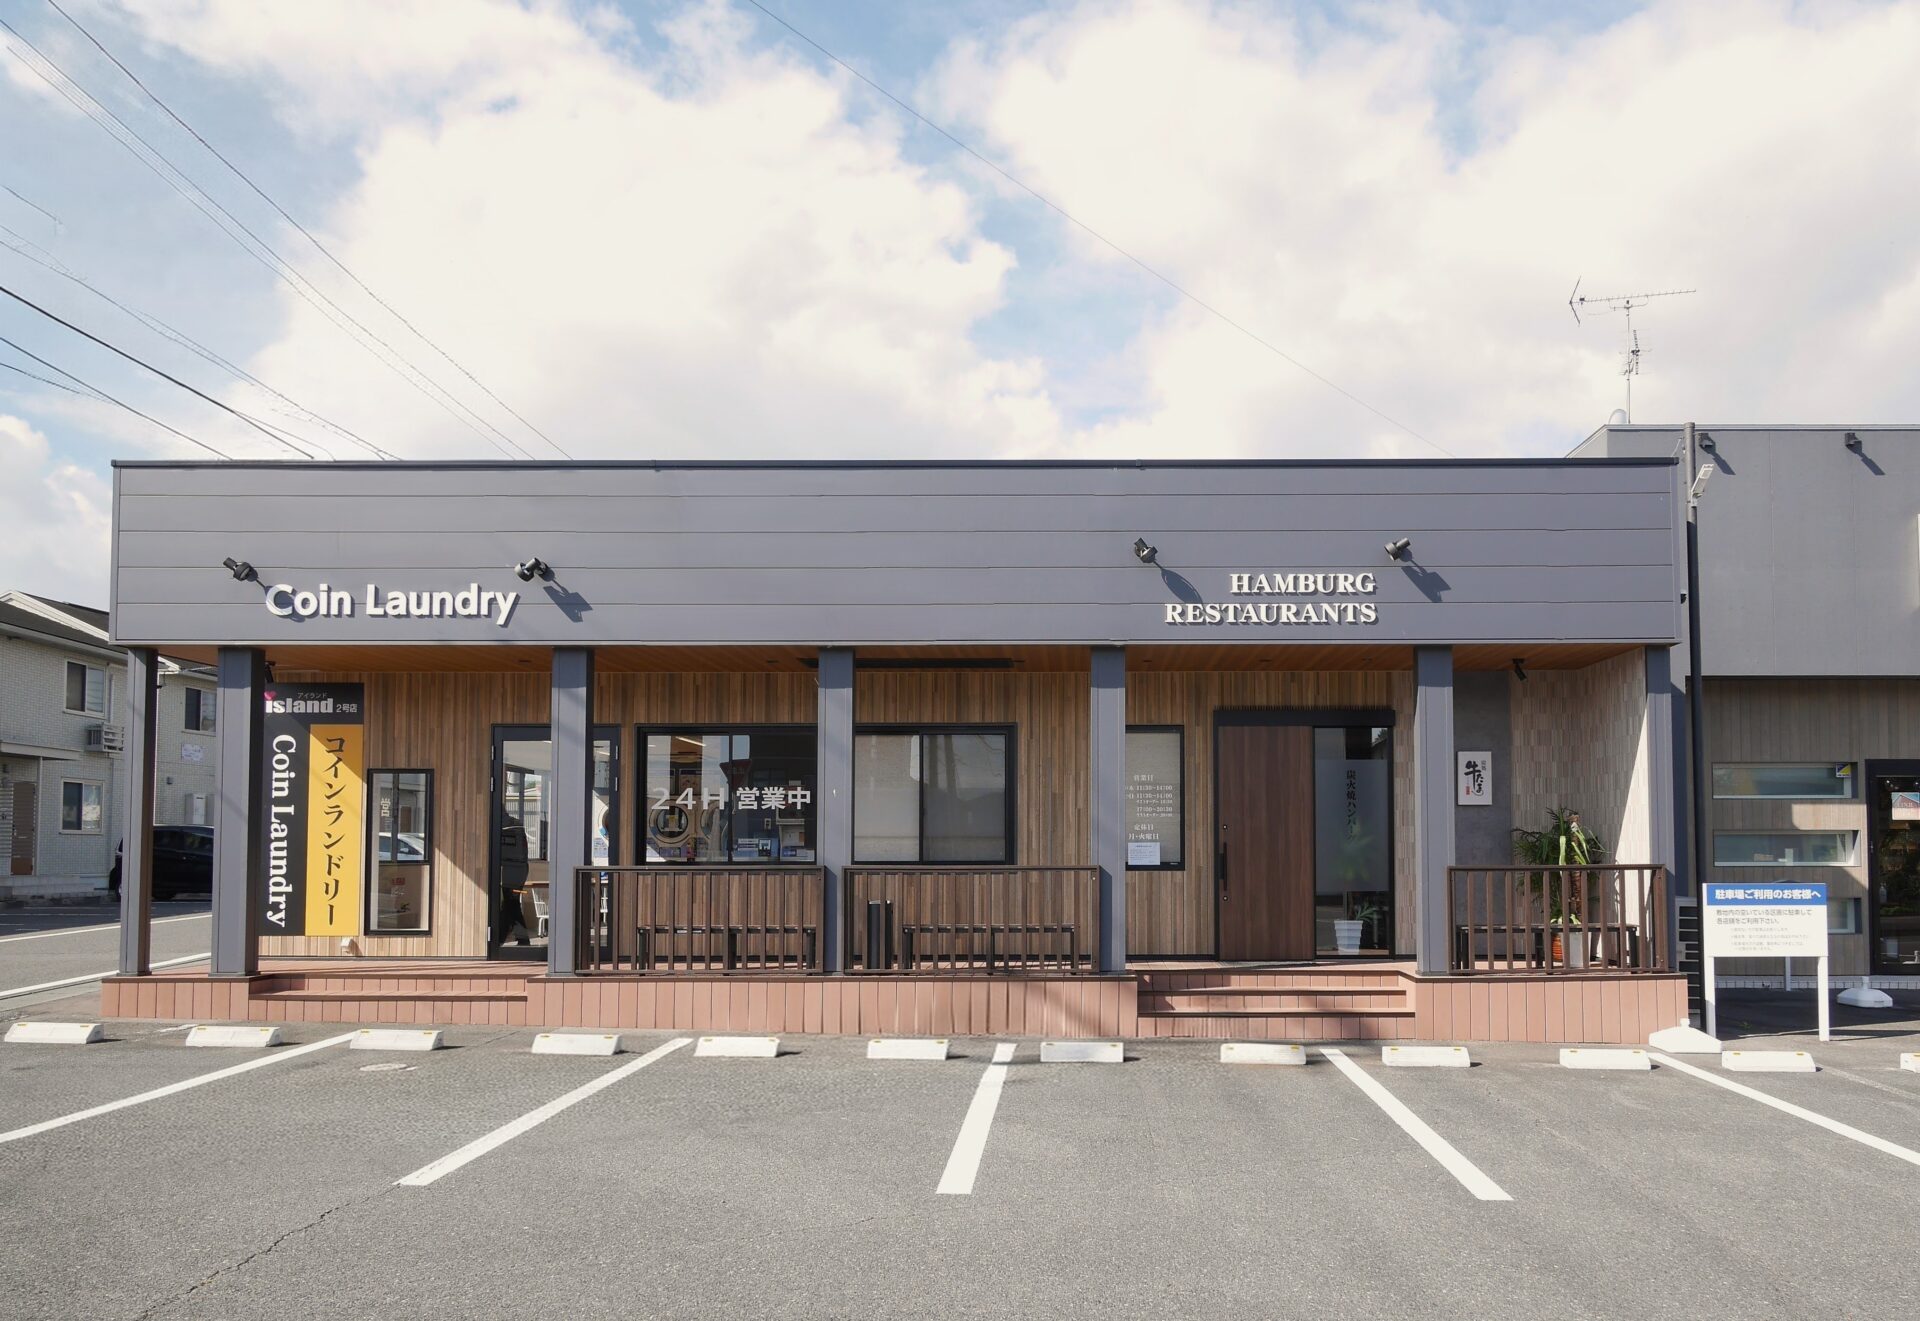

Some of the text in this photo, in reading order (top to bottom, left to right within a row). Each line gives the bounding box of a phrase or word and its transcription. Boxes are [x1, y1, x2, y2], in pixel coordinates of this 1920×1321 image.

[1230, 573, 1376, 594] HAMBURG
[266, 583, 517, 625] Coin Laundry
[1165, 603, 1377, 624] RESTAURANTS
[264, 690, 334, 714] island
[336, 703, 358, 713] 2号店
[651, 786, 811, 810] 24H 営業中
[266, 734, 297, 928] Coin Laundry
[322, 735, 348, 926] コインランドリー
[1715, 889, 1821, 900] 駐車場ご利用のお客様へ
